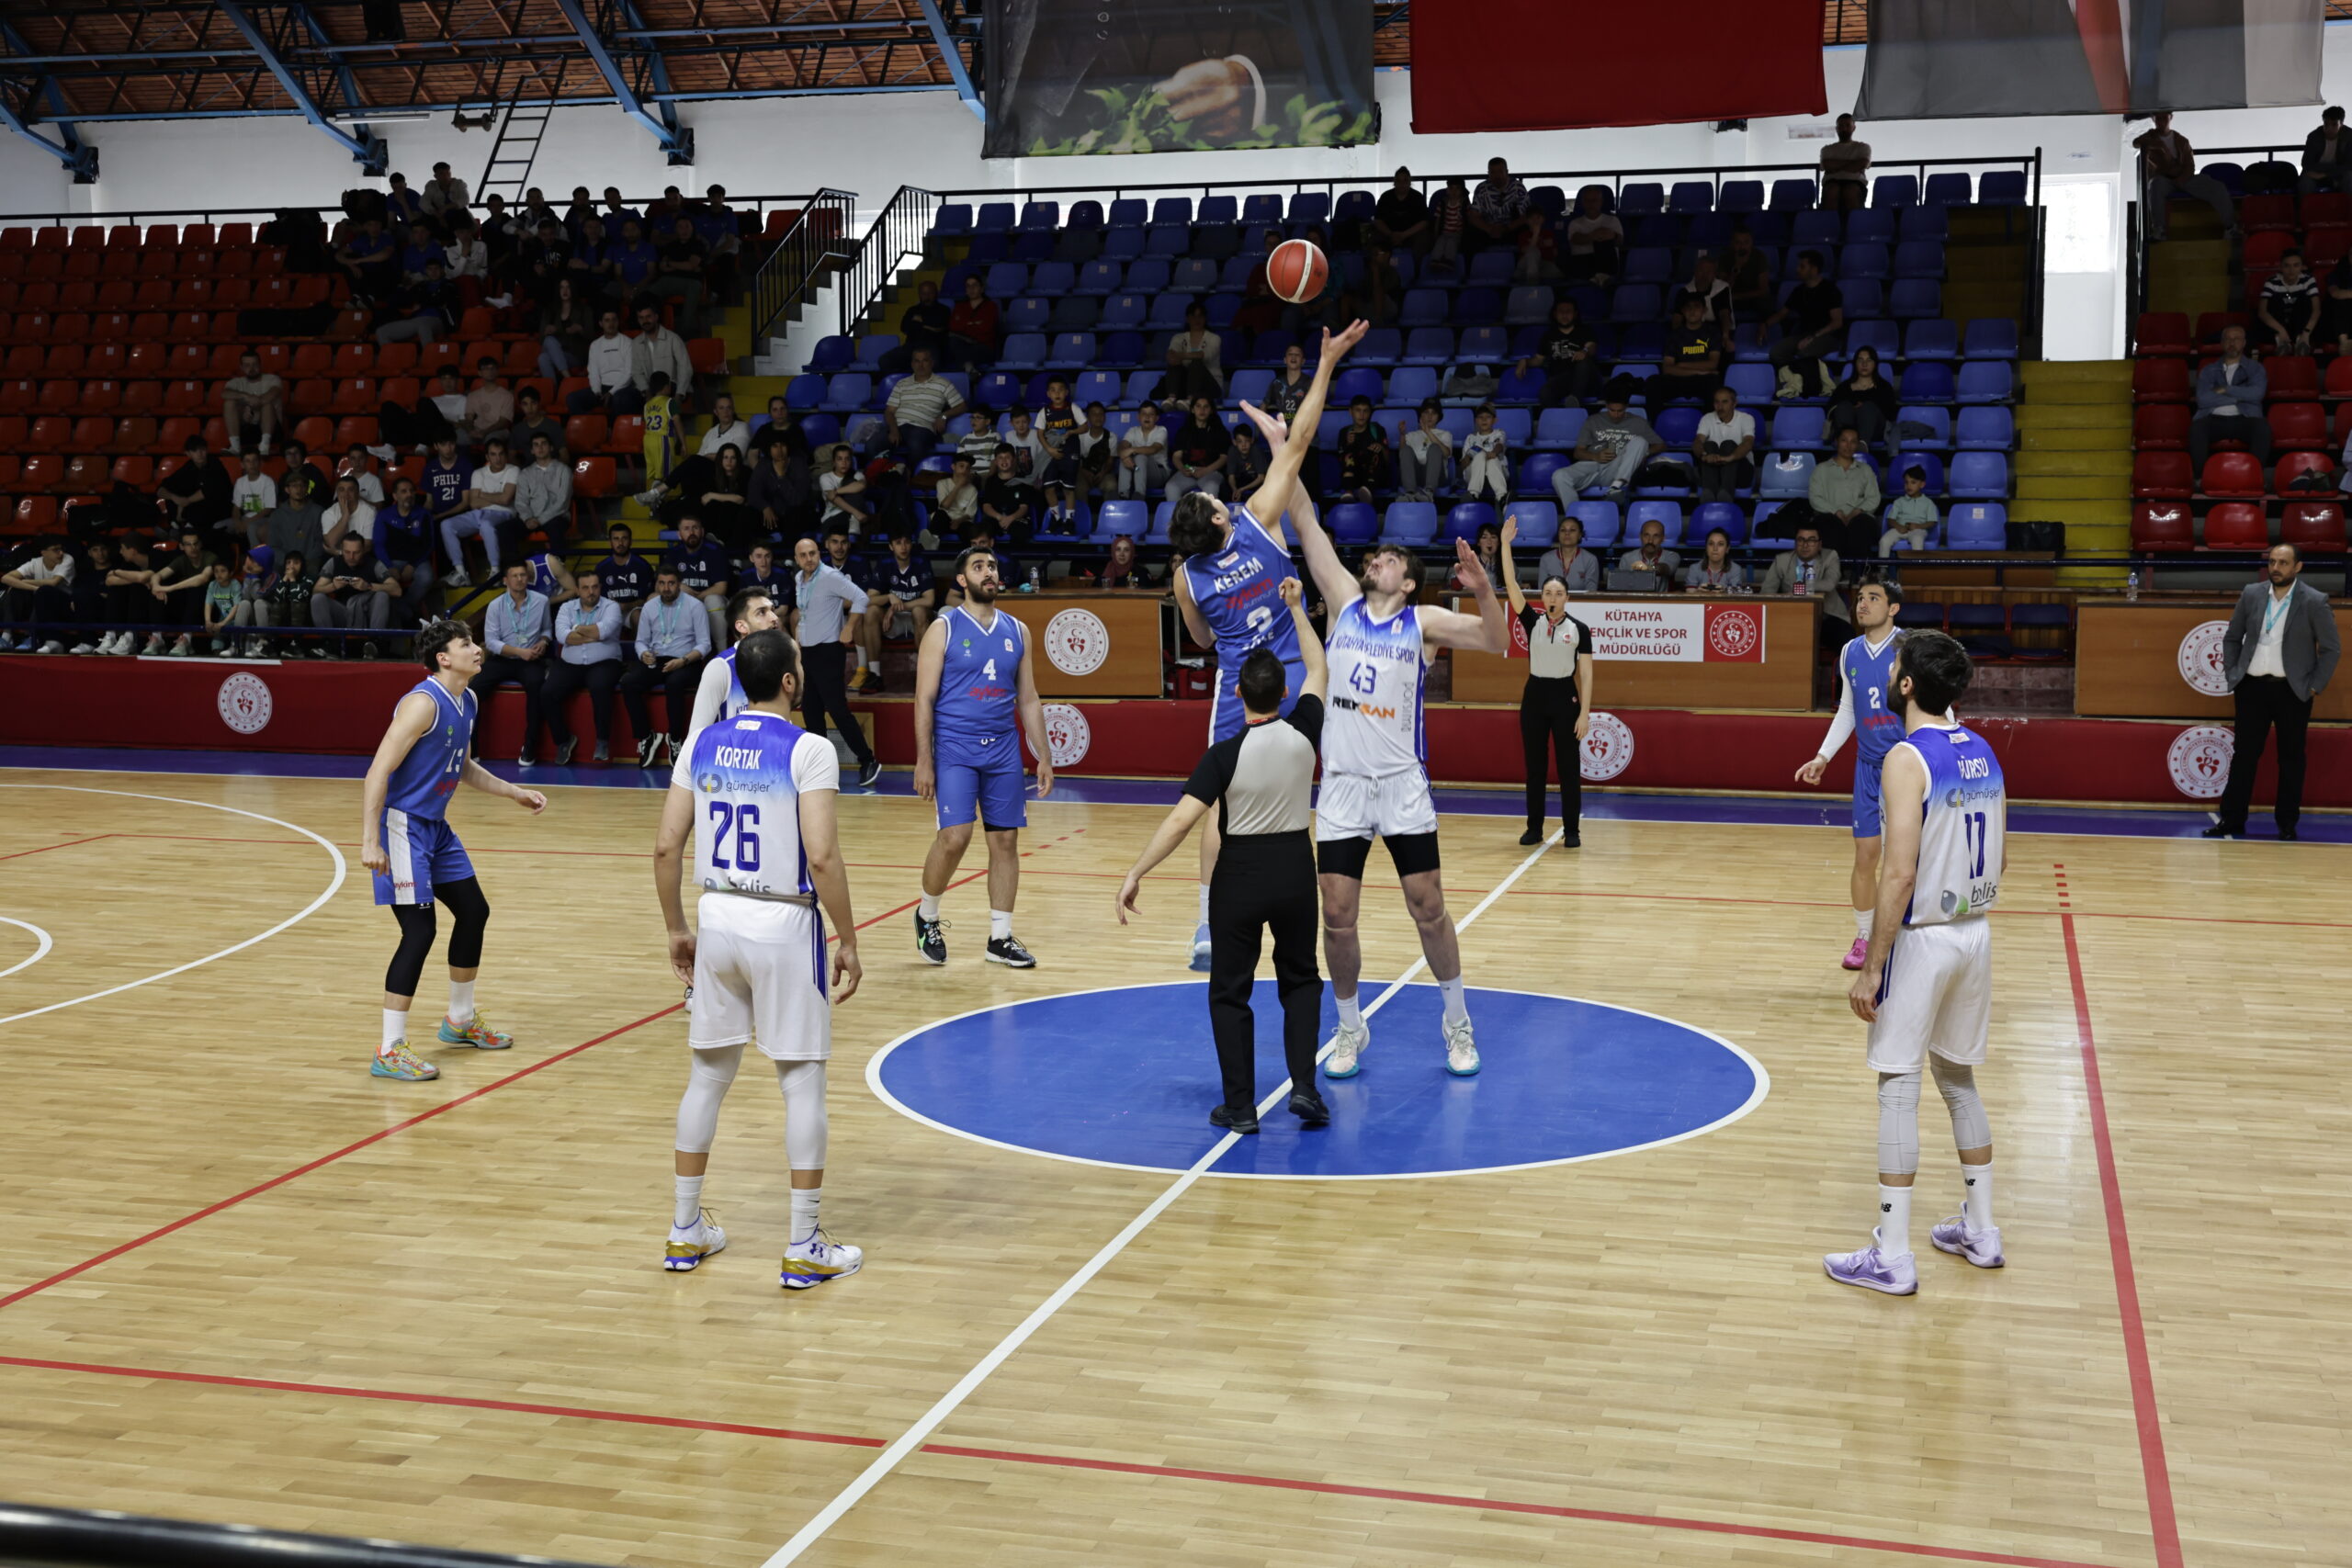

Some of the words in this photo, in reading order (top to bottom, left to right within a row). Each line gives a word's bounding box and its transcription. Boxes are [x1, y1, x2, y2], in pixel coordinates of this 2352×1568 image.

[1682, 345, 1705, 355] PUMA
[1284, 400, 1296, 412] 22
[647, 415, 662, 431] 23
[433, 474, 461, 488] PHIL
[1214, 557, 1264, 593] KEREM
[1604, 610, 1663, 623] KÜTAHYA
[1590, 626, 1634, 640] ENÇLİK
[1637, 628, 1652, 638] VE
[1655, 628, 1688, 639] SPOR
[1396, 645, 1415, 665] SPOR
[1599, 643, 1681, 656] MÜDÜRLÜĞÜ
[982, 659, 997, 681] 4
[1350, 661, 1377, 694] 43
[1868, 685, 1881, 710] 2
[715, 745, 763, 770] KORTAK
[725, 779, 771, 795] gümüşler
[710, 801, 760, 872] 26
